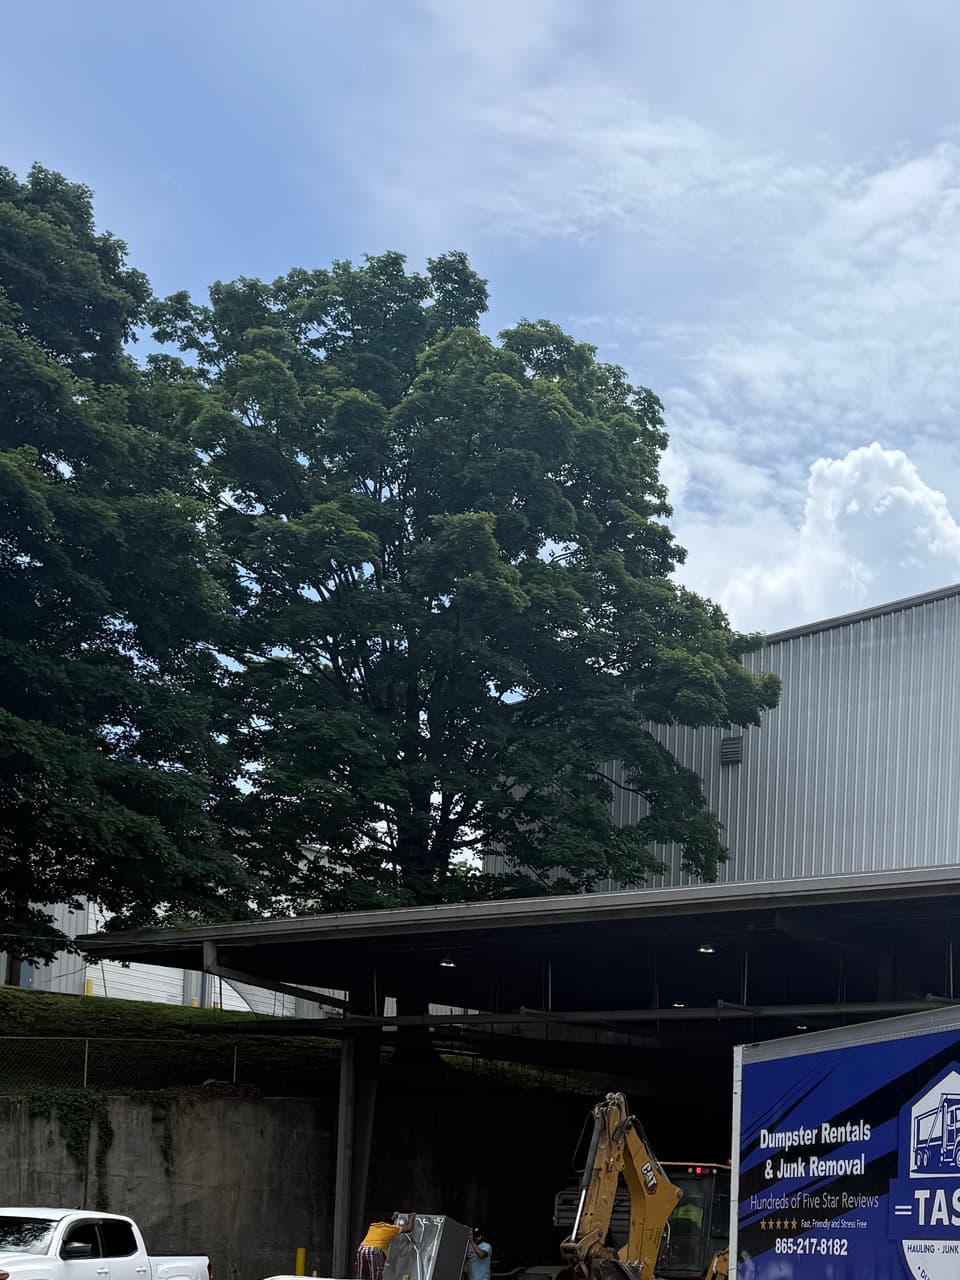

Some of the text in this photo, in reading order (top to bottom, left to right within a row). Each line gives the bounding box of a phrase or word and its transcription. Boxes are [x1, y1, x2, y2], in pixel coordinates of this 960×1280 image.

[760, 1119, 871, 1151] Dumpster Rentals
[641, 1162, 657, 1188] CAT
[764, 1153, 865, 1180] & Junk Removal
[750, 1191, 879, 1210] Hundreds of Five Star Reviews
[812, 1218, 830, 1230] Friendly
[831, 1219, 840, 1228] and
[841, 1219, 856, 1229] Stress
[856, 1219, 868, 1229] Free
[775, 1237, 848, 1256] 865-217-8182
[907, 1244, 935, 1254] HAULING
[942, 1245, 959, 1255] JUNK
